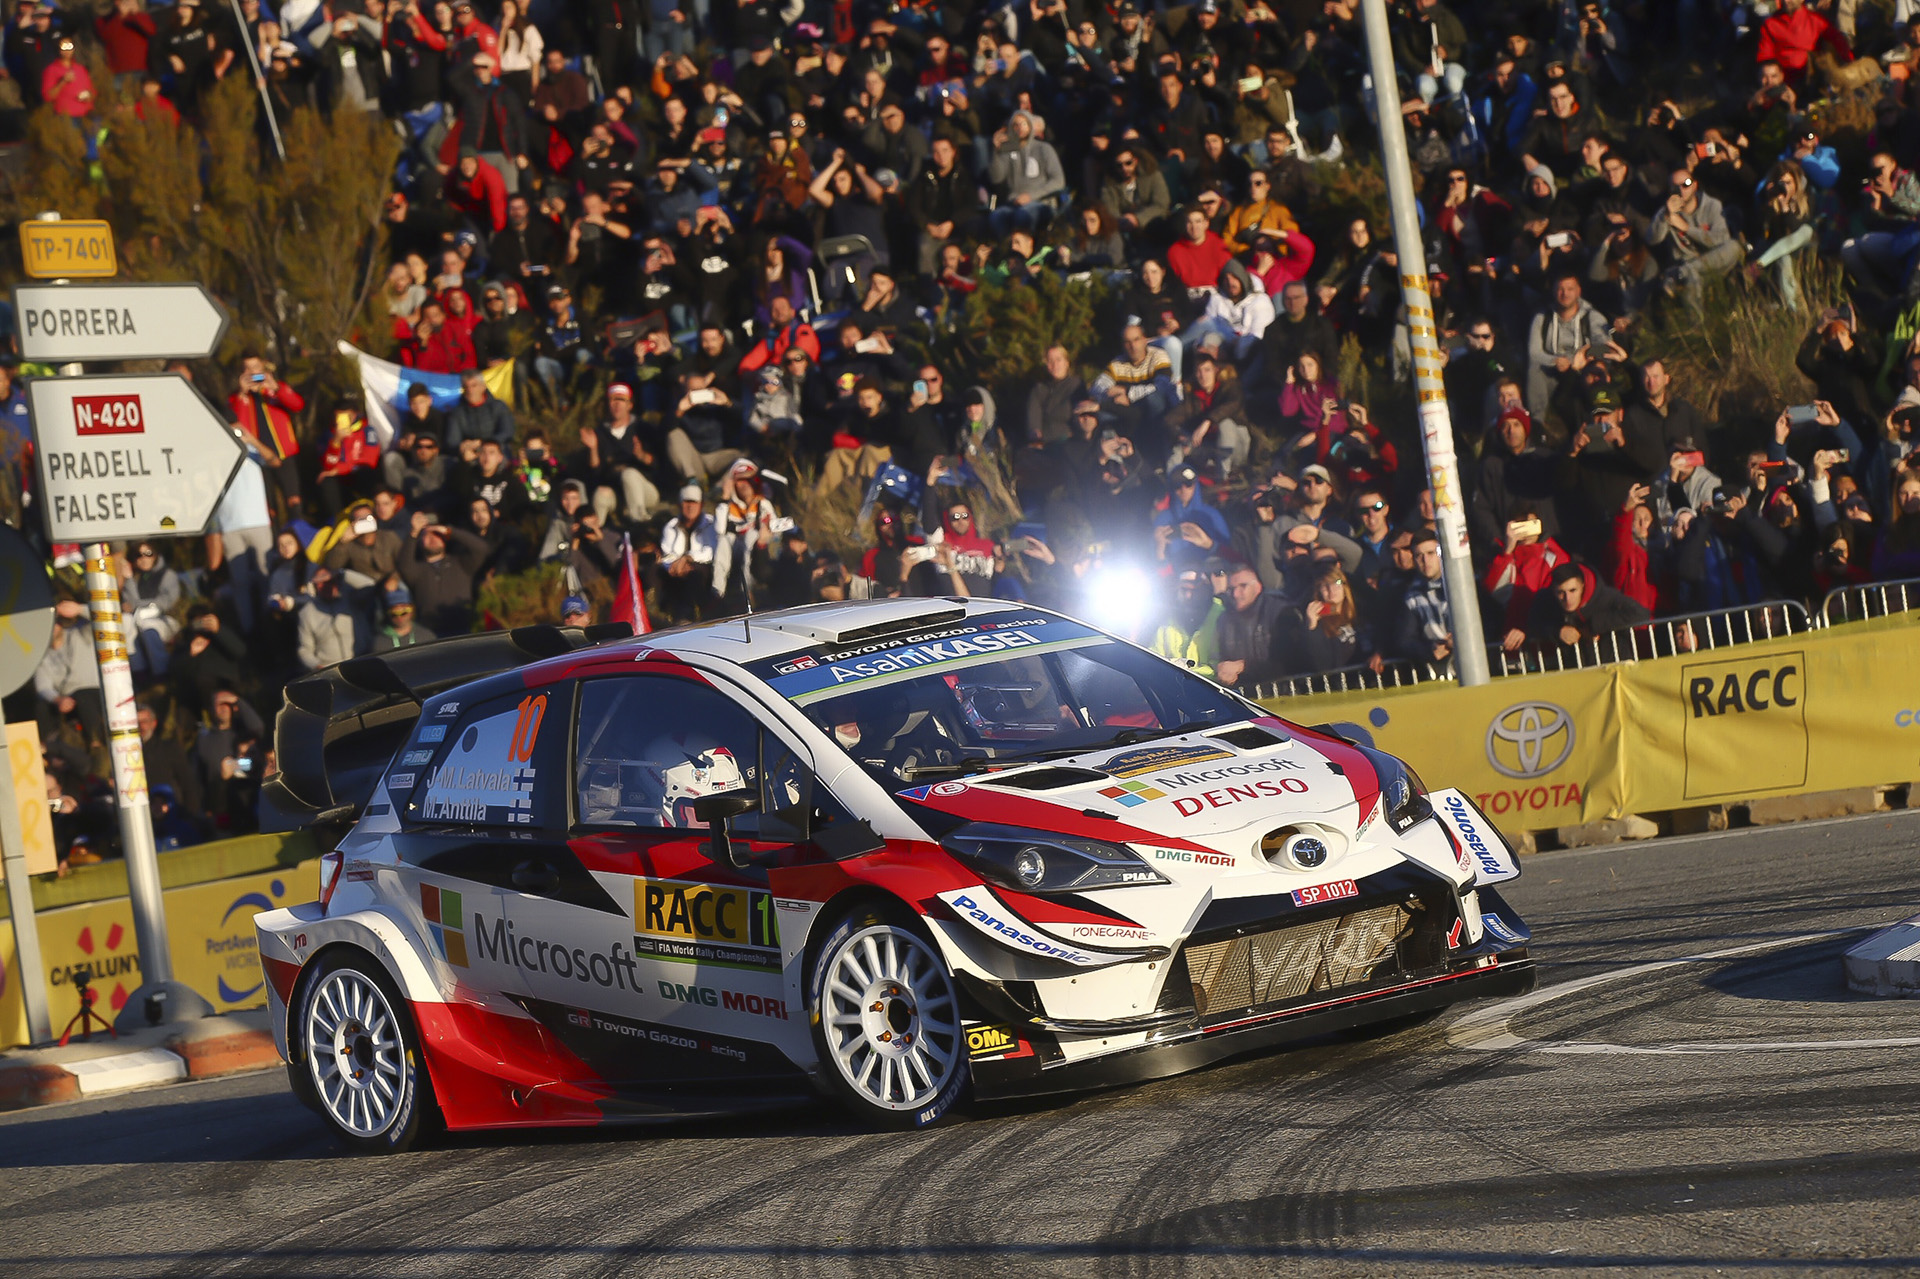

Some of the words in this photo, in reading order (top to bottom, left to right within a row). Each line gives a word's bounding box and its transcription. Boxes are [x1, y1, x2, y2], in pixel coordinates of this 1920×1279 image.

[31, 238, 109, 261] TP-7401
[25, 308, 137, 337] PORRERA
[75, 400, 141, 429] N-420
[47, 450, 152, 480] PRADELL
[161, 448, 182, 475] T.
[53, 491, 138, 523] FALSET
[820, 639, 903, 662] TOYOTA
[905, 626, 978, 644] GAZOO
[979, 618, 1047, 631] Racing
[1690, 666, 1797, 719] RACC
[507, 694, 548, 763] 10
[1155, 758, 1304, 789] Microsoft
[439, 798, 487, 821] Anttila
[1172, 778, 1309, 818] DENSO
[1476, 783, 1582, 814] TOYOTA
[1446, 796, 1508, 875] Panasonic
[1155, 849, 1191, 862] DMG
[1194, 854, 1236, 867] MORI
[1122, 872, 1158, 881] PIAA
[1301, 887, 1320, 903] SP
[1322, 880, 1356, 899] 1012
[645, 885, 736, 939] RACC
[951, 894, 1091, 964] Panasonic
[473, 912, 644, 994] Microsoft
[658, 943, 671, 954] FIA
[672, 945, 694, 956] World
[716, 949, 767, 965] Championship
[51, 954, 141, 986] CATALUNY
[658, 980, 718, 1007] DMG
[721, 990, 789, 1021] MORI
[567, 1013, 591, 1028] GR
[593, 1018, 647, 1039] TOYOTA
[649, 1031, 698, 1050] GAZOO
